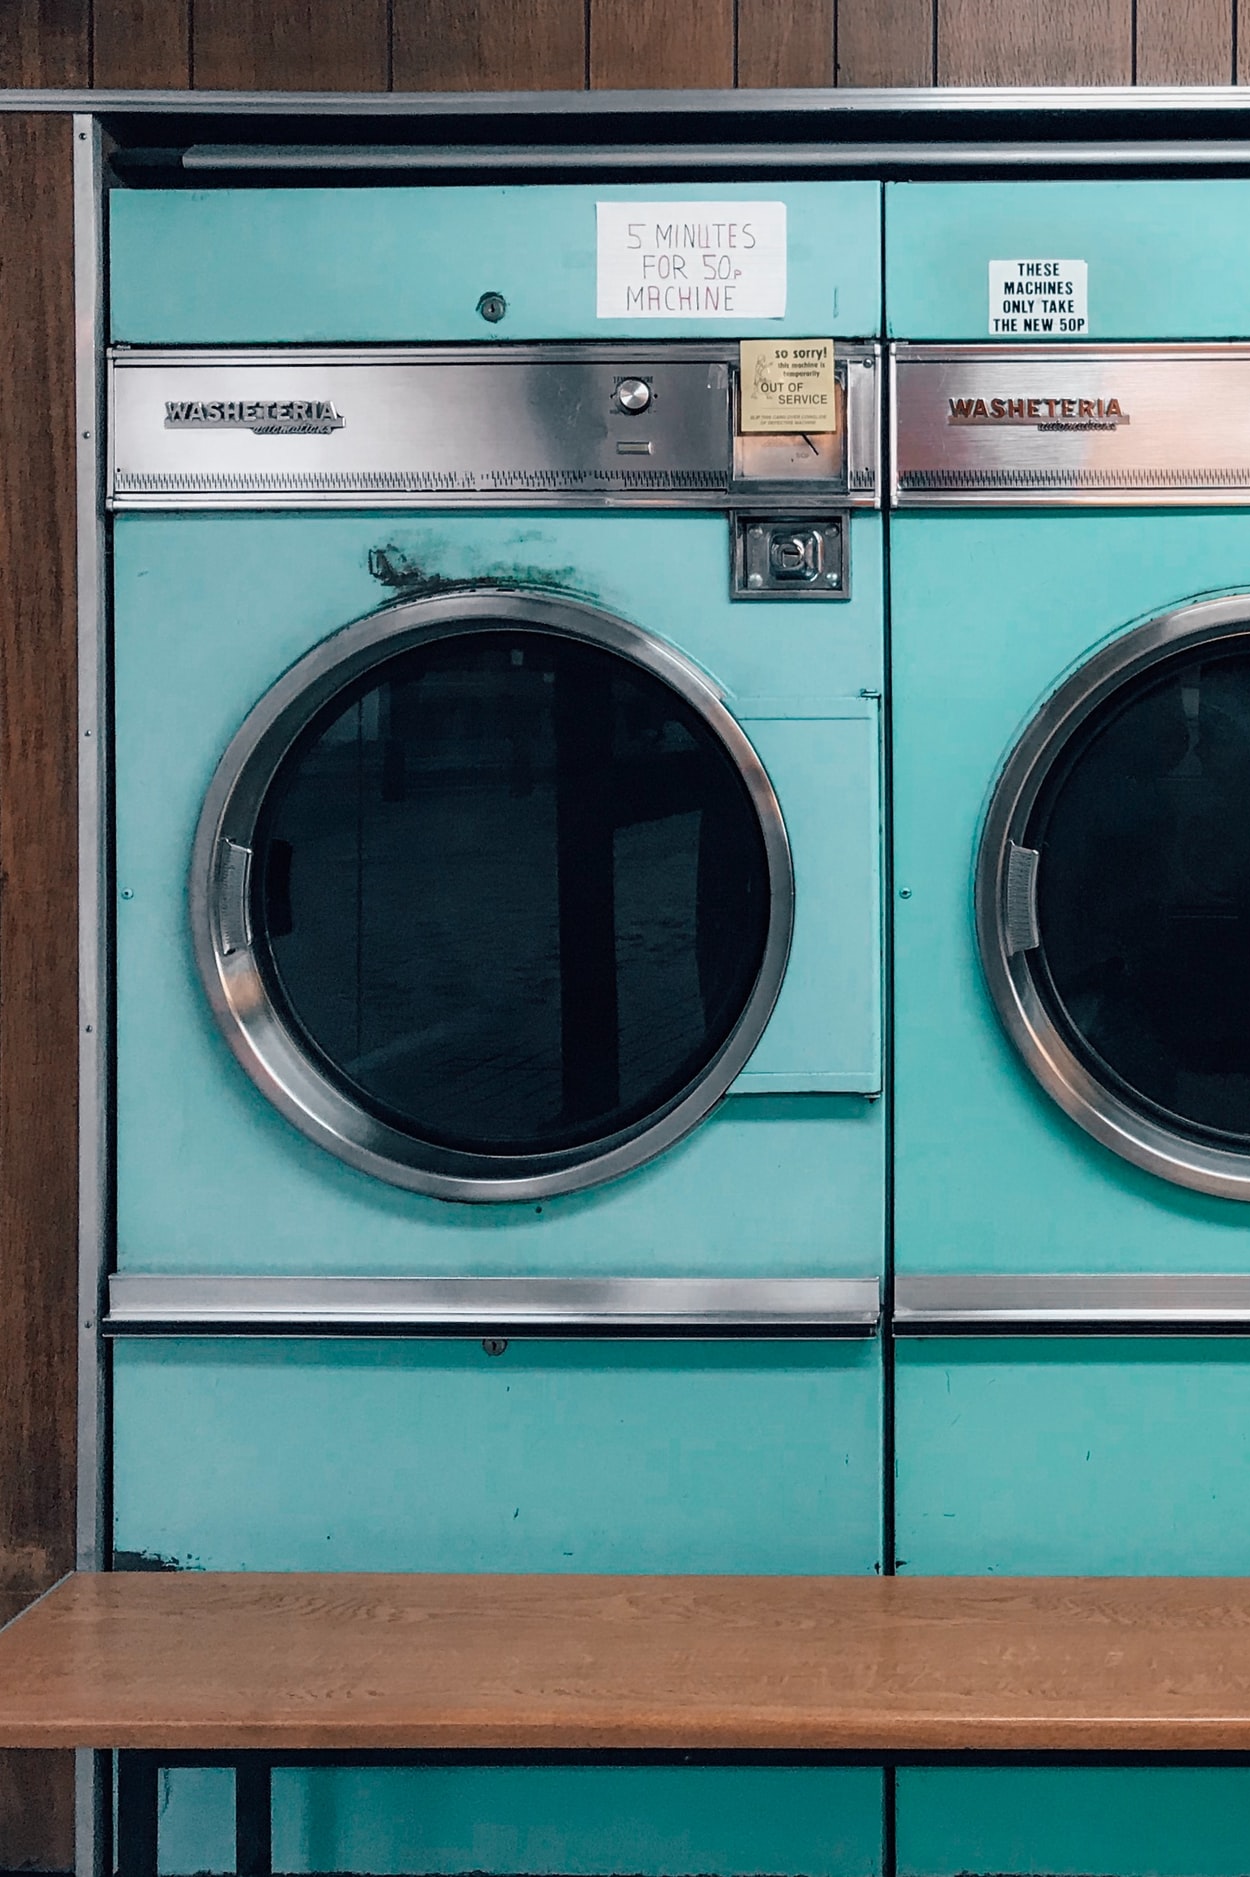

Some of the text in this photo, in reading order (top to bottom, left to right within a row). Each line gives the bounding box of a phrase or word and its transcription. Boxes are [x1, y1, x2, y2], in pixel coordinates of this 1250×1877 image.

[627, 223, 756, 249] 5 MINUTES
[643, 254, 688, 280] FOR
[1017, 263, 1060, 277] THESE
[1003, 281, 1073, 295] MACHINES
[626, 285, 736, 311] MACHINE
[1003, 300, 1074, 313] ONLY TAKE
[993, 318, 1085, 332] THE NEW 50P
[775, 346, 828, 361] so sorry!
[760, 382, 804, 393] OUT OF
[778, 394, 828, 405] SERVICE
[165, 400, 340, 421] WASHETERIA
[948, 398, 1123, 418] WASHETERIA
